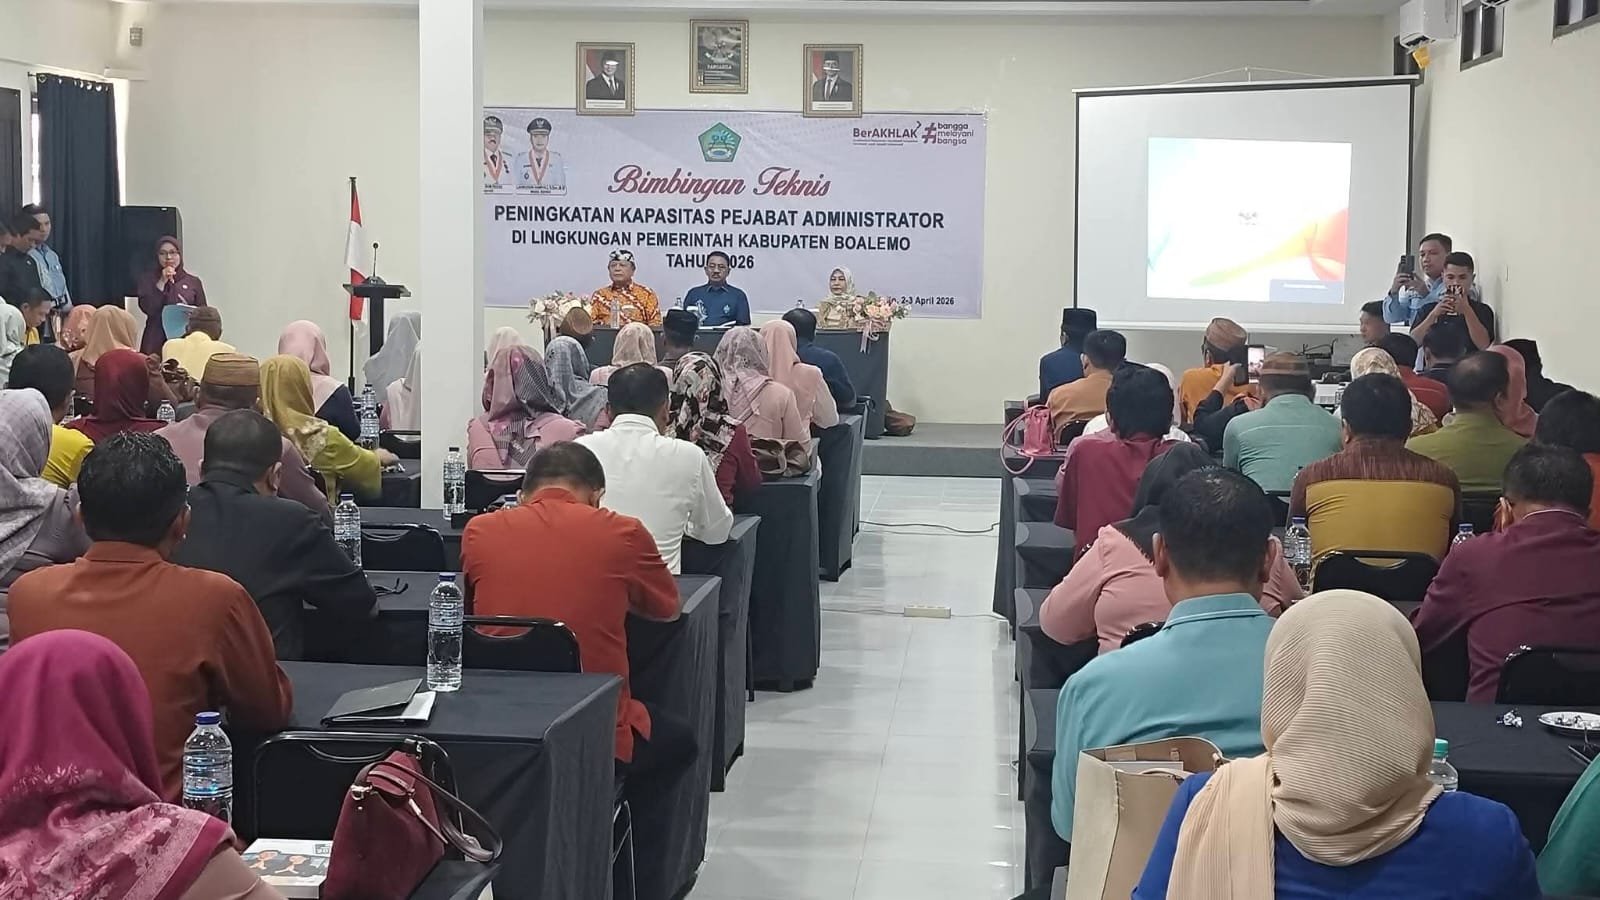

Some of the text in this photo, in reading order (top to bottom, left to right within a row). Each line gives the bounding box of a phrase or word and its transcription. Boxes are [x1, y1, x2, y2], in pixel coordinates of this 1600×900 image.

[853, 126, 919, 138] BerAKHLAK
[937, 122, 968, 130] bangga
[937, 129, 974, 138] melayani
[937, 138, 967, 146] bangsa
[608, 164, 831, 202] Bimbingan Teknis
[494, 205, 945, 229] PENINGKATAN KAPASITAS PEJABAT ADMINISTRATOR
[512, 229, 911, 251] DI LINGKUNGAN PEMERINTAH KABUPATEN BOALEMO
[666, 253, 754, 269] TAHU 026
[915, 296, 934, 306] April
[936, 296, 955, 305] 2026
